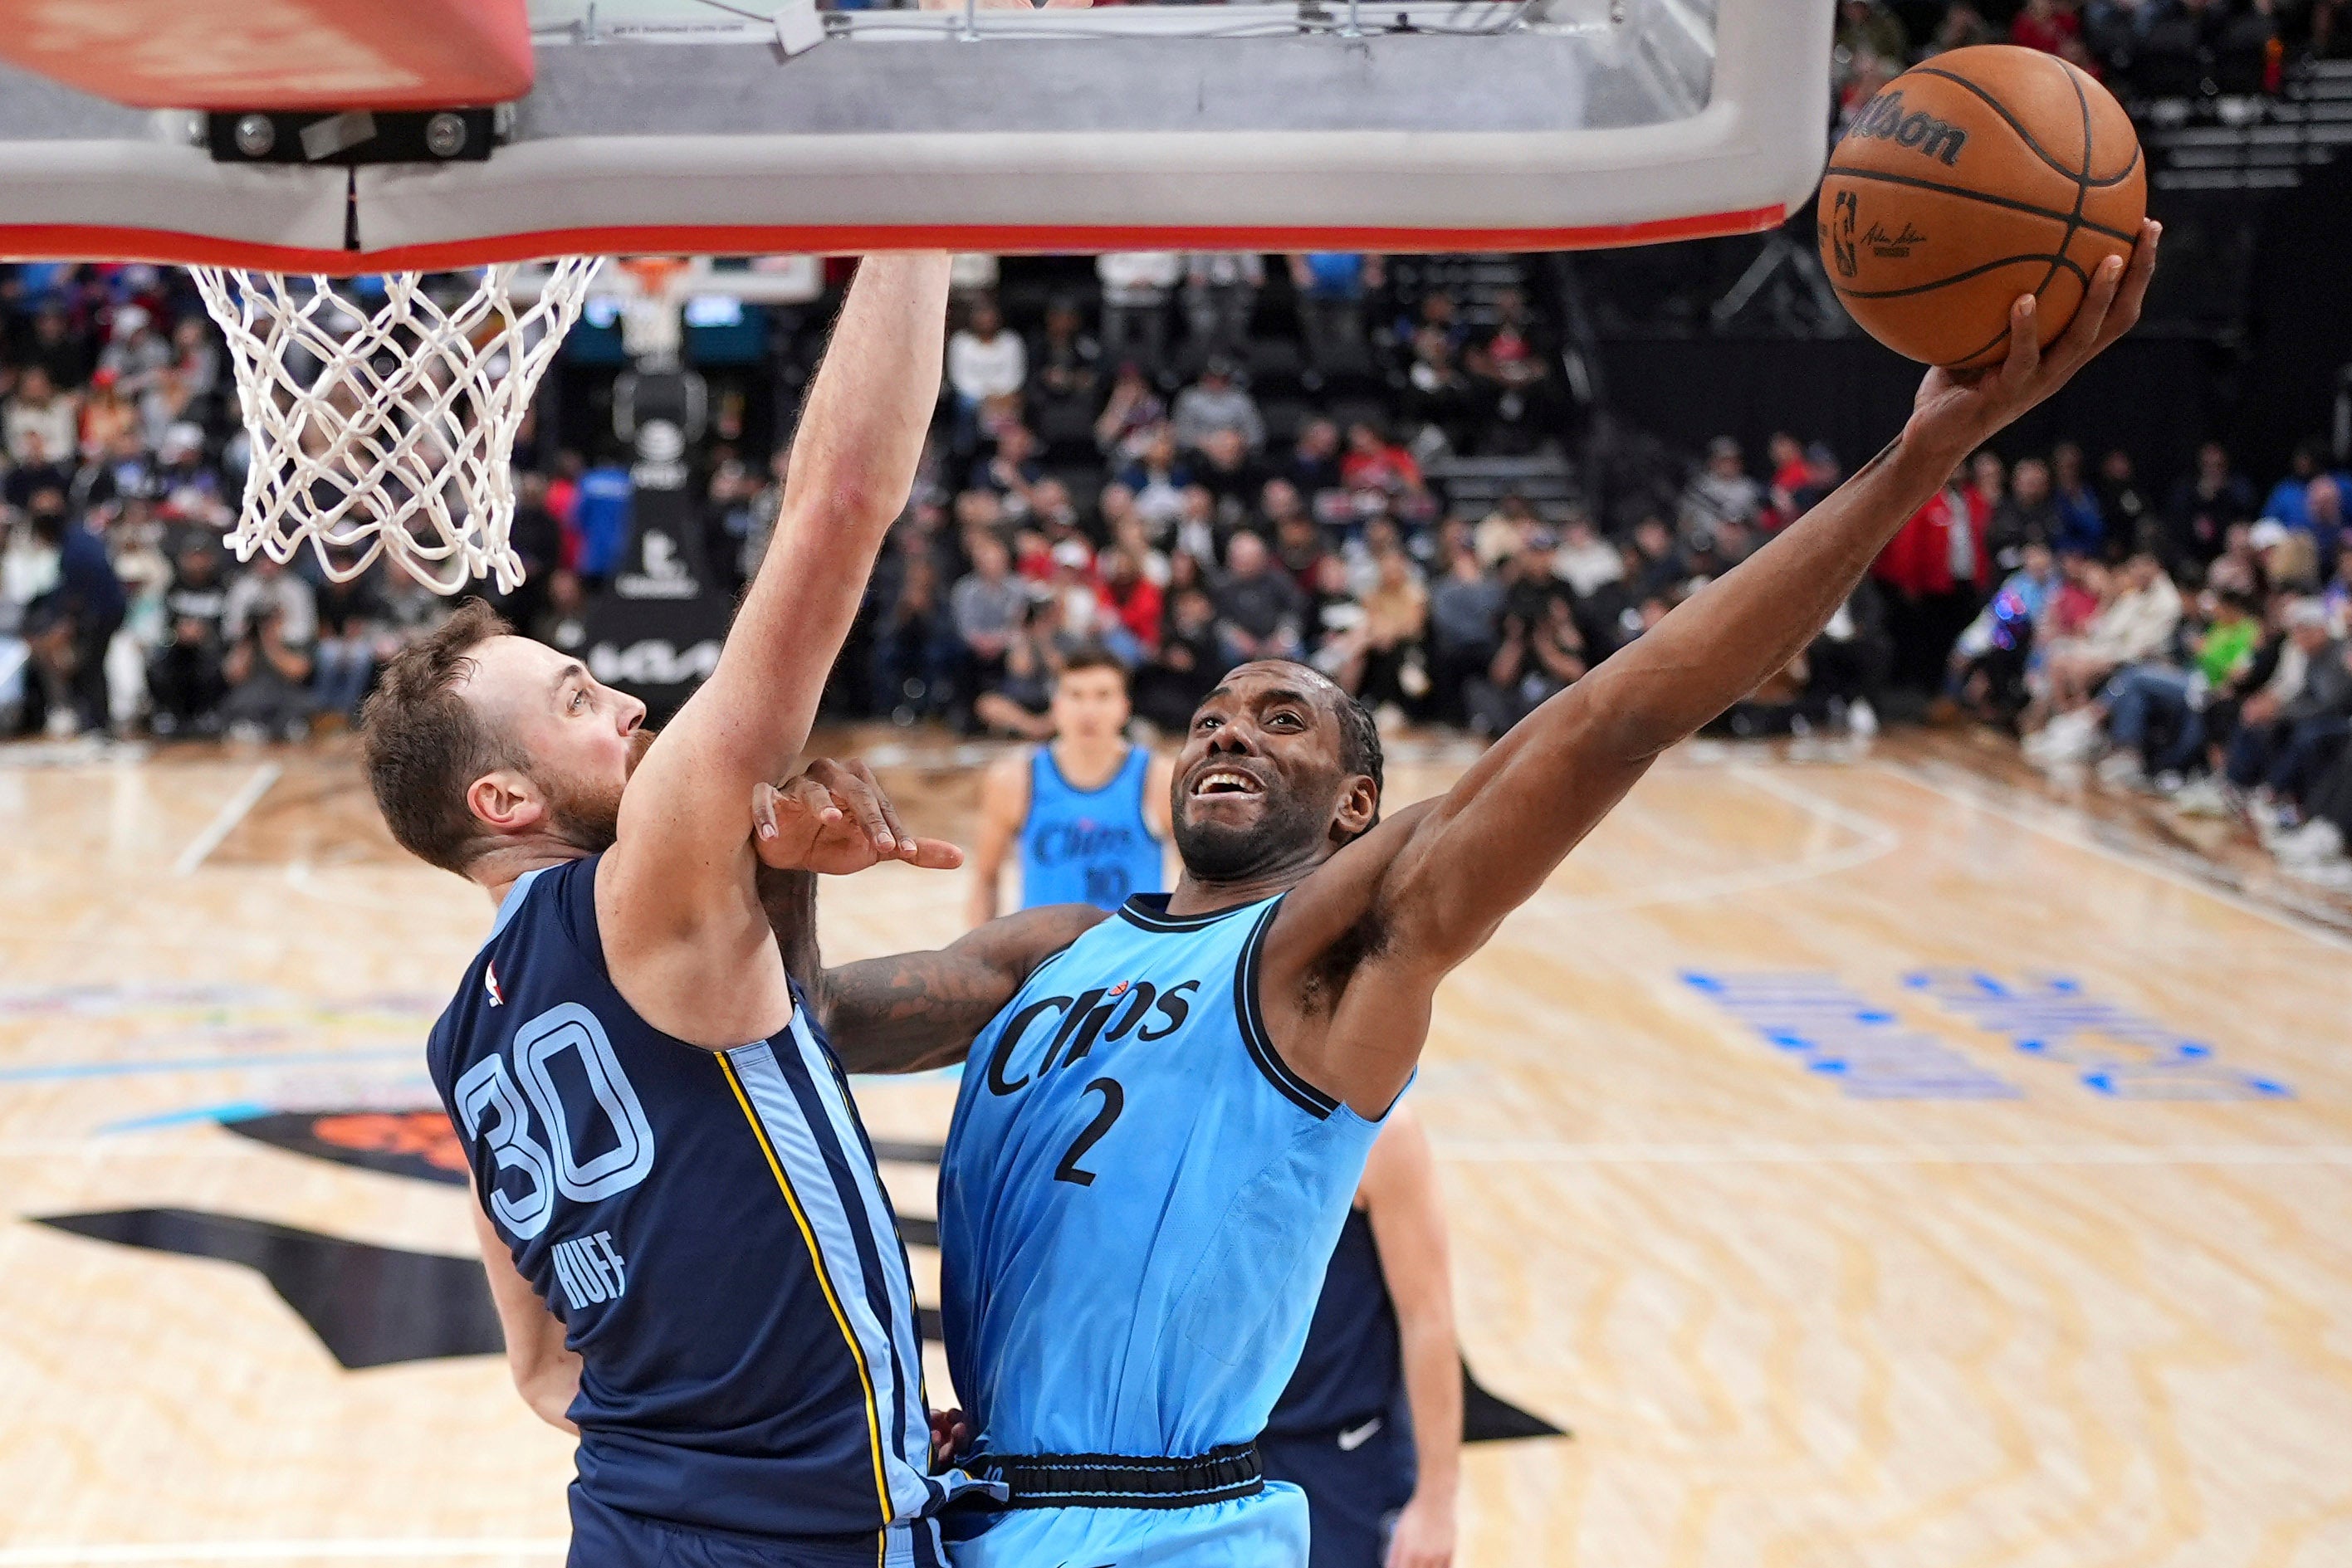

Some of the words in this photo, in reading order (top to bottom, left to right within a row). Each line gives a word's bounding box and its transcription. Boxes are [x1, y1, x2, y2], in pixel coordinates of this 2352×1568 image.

[1851, 90, 1968, 166] ilson
[988, 979, 1200, 1097] Clips
[454, 1002, 655, 1240] 30
[1054, 1077, 1123, 1187] 2
[550, 1230, 625, 1309] HUFF
